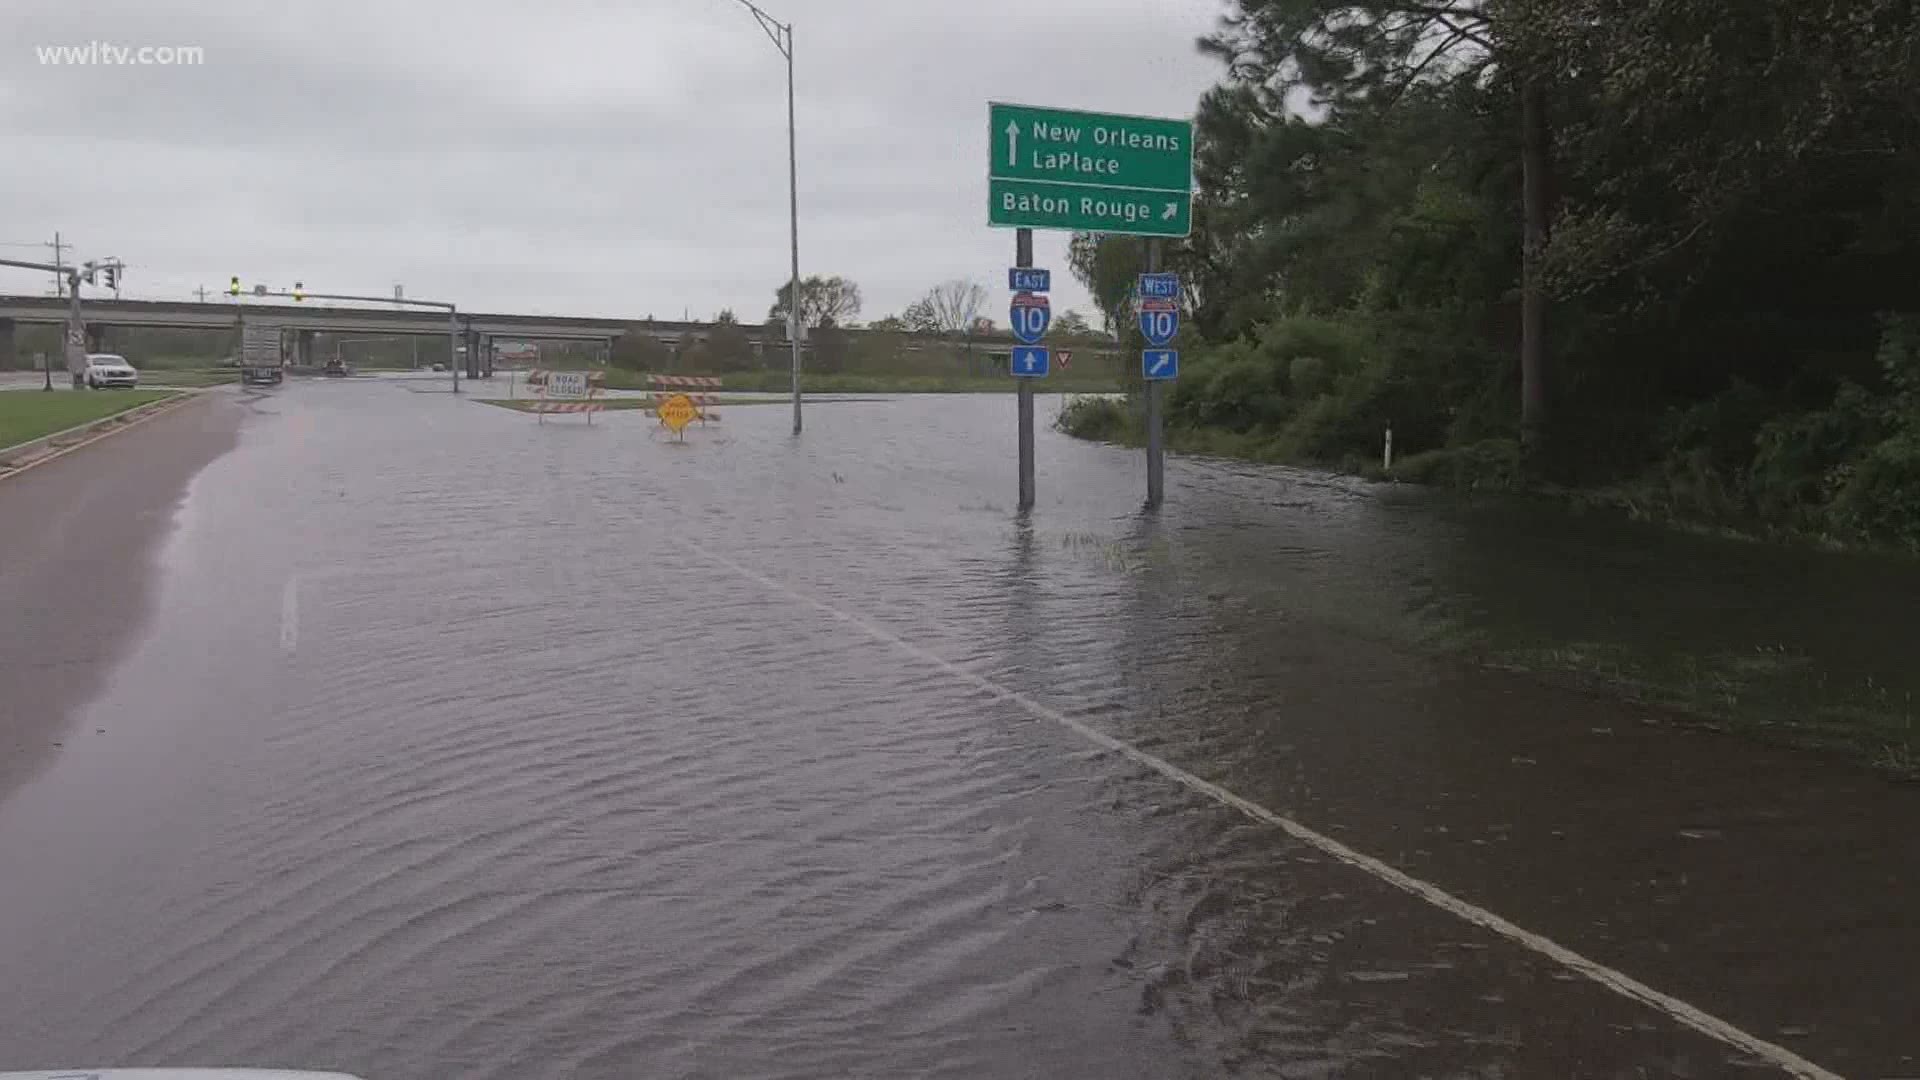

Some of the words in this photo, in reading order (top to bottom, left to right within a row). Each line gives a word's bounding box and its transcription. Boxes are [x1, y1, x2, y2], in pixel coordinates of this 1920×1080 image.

[1033, 121, 1081, 144] New
[1094, 127, 1180, 151] Orleans
[1033, 151, 1120, 174] LaPlace
[1003, 192, 1070, 214] Baton
[1081, 197, 1150, 222] Rouge
[1015, 272, 1045, 288] EAST
[1144, 279, 1174, 294] WEST
[1019, 307, 1044, 333] 10
[1149, 313, 1172, 337] 10
